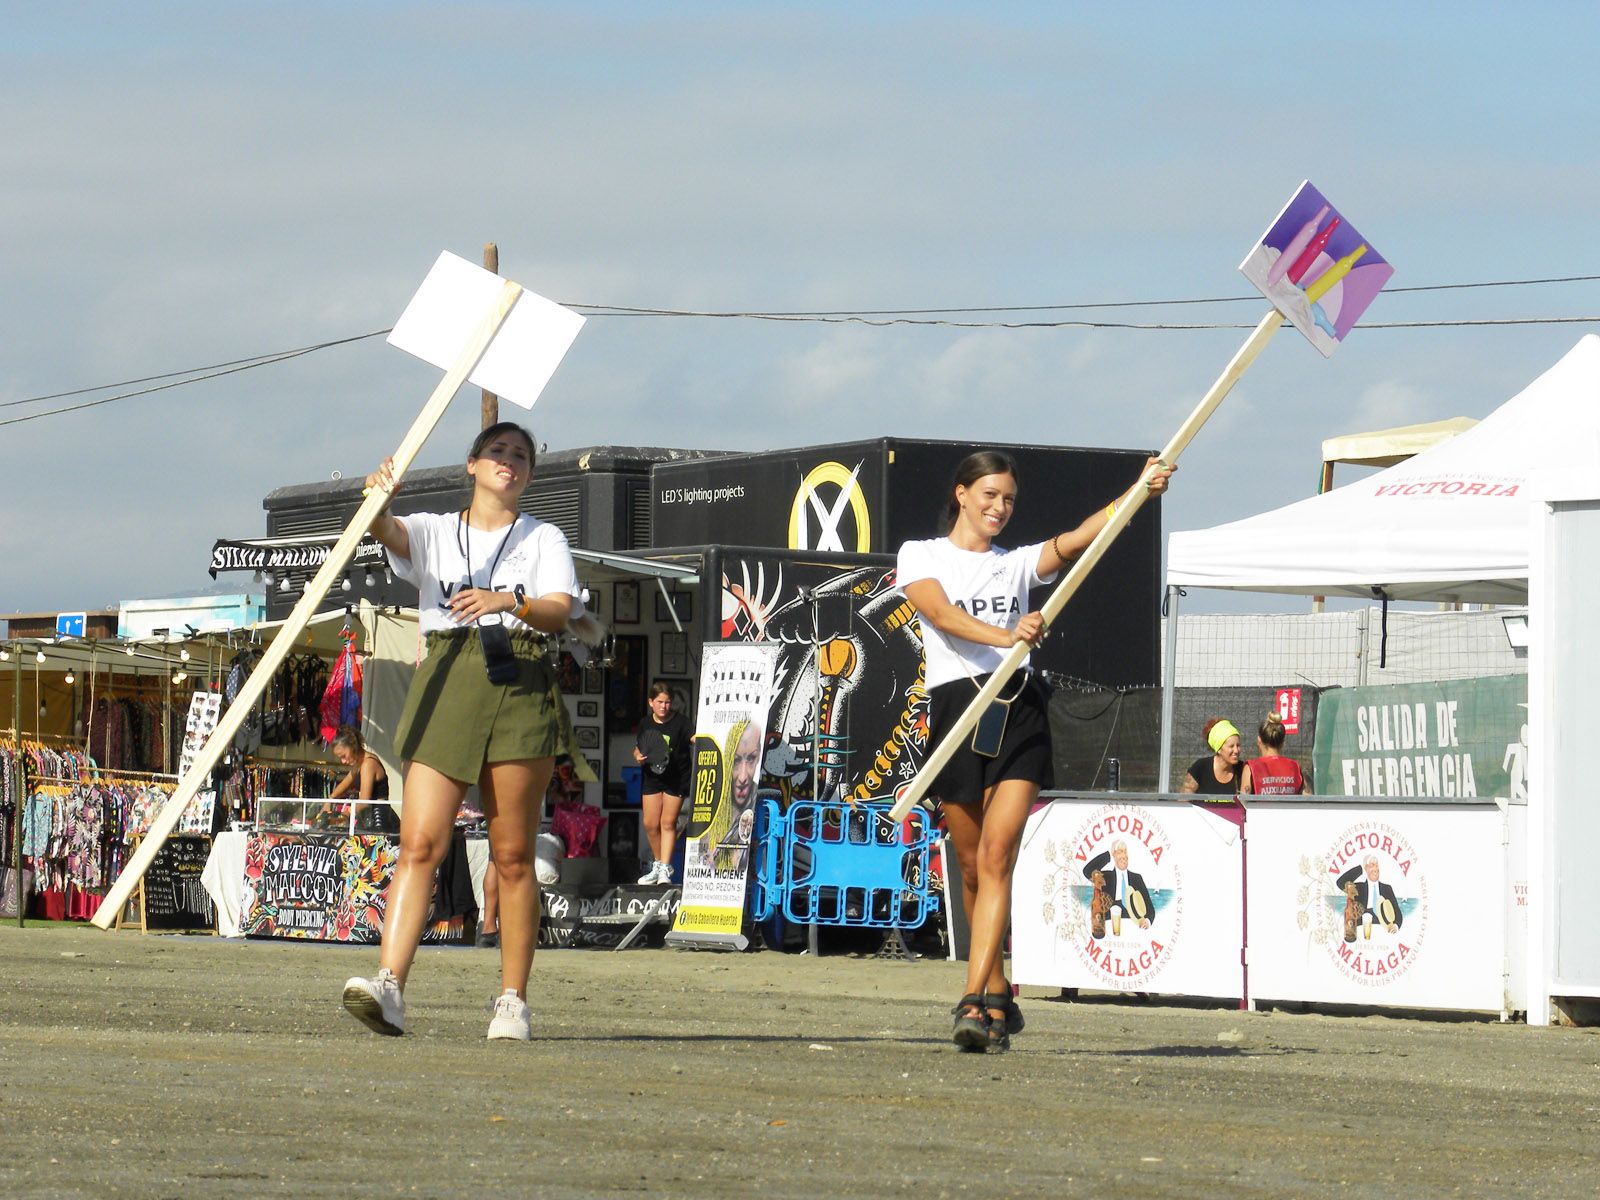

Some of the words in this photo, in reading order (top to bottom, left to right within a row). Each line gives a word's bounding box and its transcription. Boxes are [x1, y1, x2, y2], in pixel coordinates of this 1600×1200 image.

[683, 487, 713, 505] lighting
[713, 485, 745, 502] projects
[1374, 482, 1520, 497] VICTORIA
[211, 546, 265, 569] SYLVIA
[1357, 703, 1428, 753] SALIDA
[1436, 700, 1459, 748] DE
[698, 750, 718, 766] OFERTA
[694, 768, 717, 805] 12€
[1341, 753, 1478, 798] EMERGENCIA
[1075, 814, 1164, 865] VICTORIA
[1328, 832, 1412, 877] VICTORIA
[268, 844, 338, 877] SYLVIA
[713, 868, 744, 880] HIGIENE
[265, 872, 344, 906] MALCOM
[277, 908, 295, 926] BODY
[295, 908, 326, 928] PIERCING
[1084, 937, 1164, 977] MÁLAGA
[1336, 941, 1411, 976] MÁLAGA
